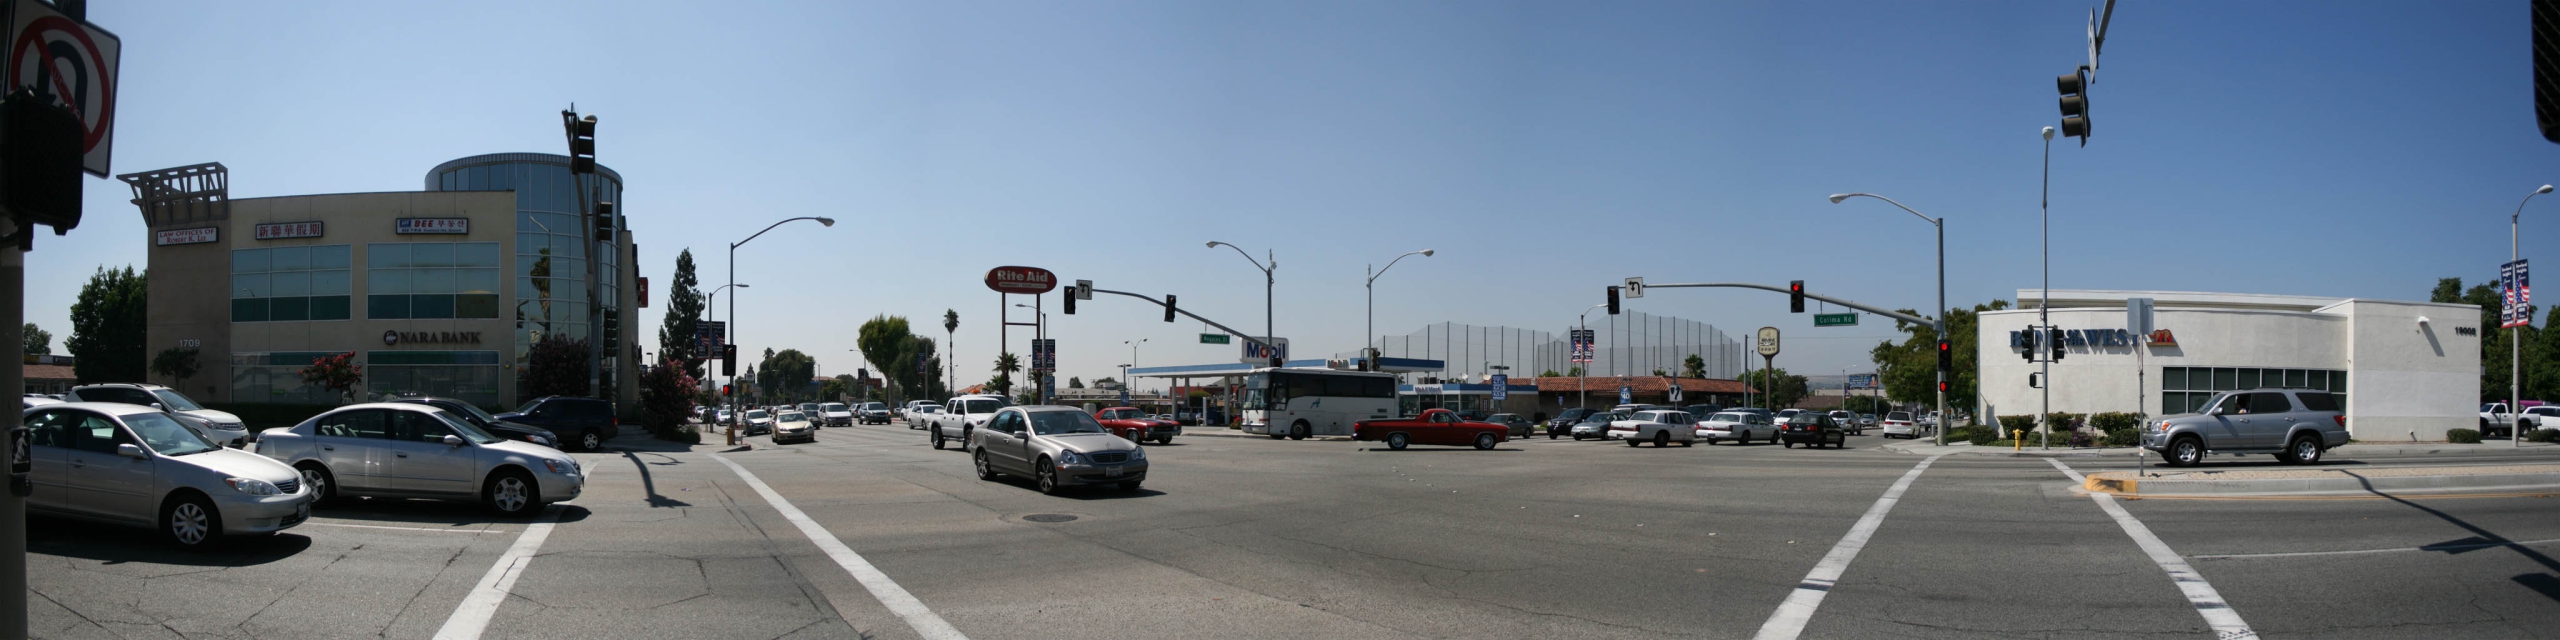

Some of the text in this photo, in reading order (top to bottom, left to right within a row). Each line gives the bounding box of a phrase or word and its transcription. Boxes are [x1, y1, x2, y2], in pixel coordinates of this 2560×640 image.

[414, 220, 434, 228] BEE
[176, 229, 203, 237] OFFICES
[997, 269, 1049, 282] Rite Aid
[1819, 316, 1841, 324] Colima
[399, 331, 481, 343] NARA BANK
[2009, 330, 2063, 347] BN
[2064, 337, 2085, 346] THE
[180, 339, 200, 348] 1709
[1246, 341, 1286, 359] Mobil
